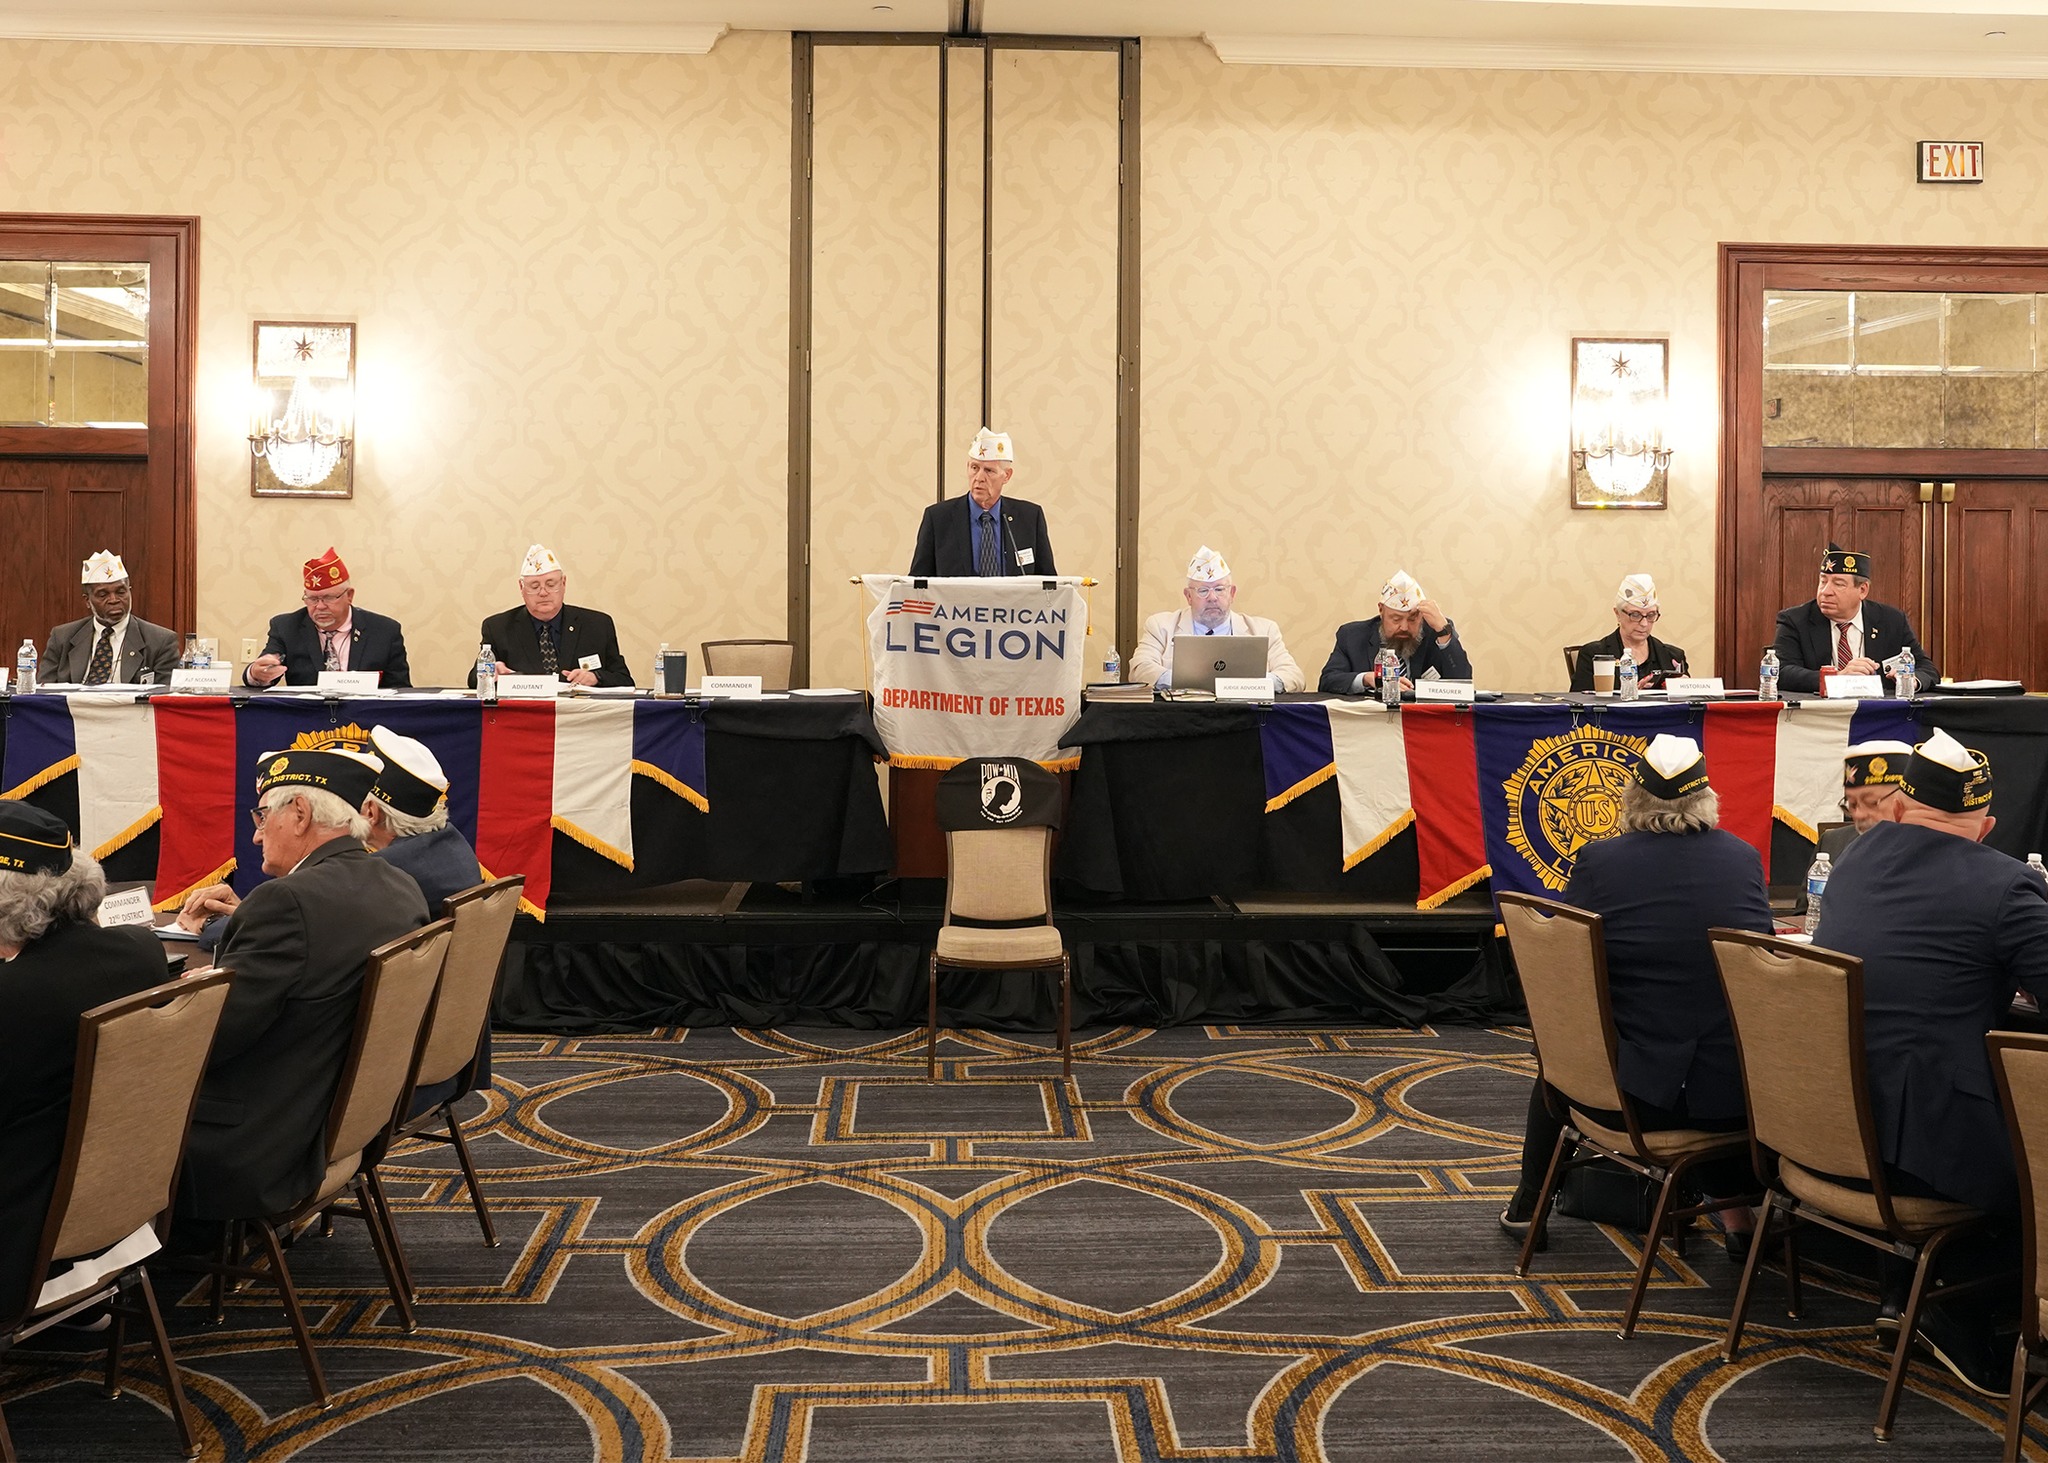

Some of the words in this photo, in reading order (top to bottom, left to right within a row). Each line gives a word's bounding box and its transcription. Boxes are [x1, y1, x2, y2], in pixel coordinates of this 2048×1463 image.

[1929, 145, 1979, 176] EXIT
[934, 604, 1066, 624] AMERICAN
[886, 621, 1066, 660] LEGION
[882, 687, 984, 715] DEPARTMENT
[989, 697, 1009, 716] OF
[1015, 697, 1065, 716] TEXAS
[272, 773, 312, 783] DISTRICT,
[315, 775, 328, 785] TX
[381, 792, 392, 803] TX
[13, 858, 25, 868] TX
[104, 896, 141, 909] COMMANDER
[121, 910, 145, 922] DISTRICT
